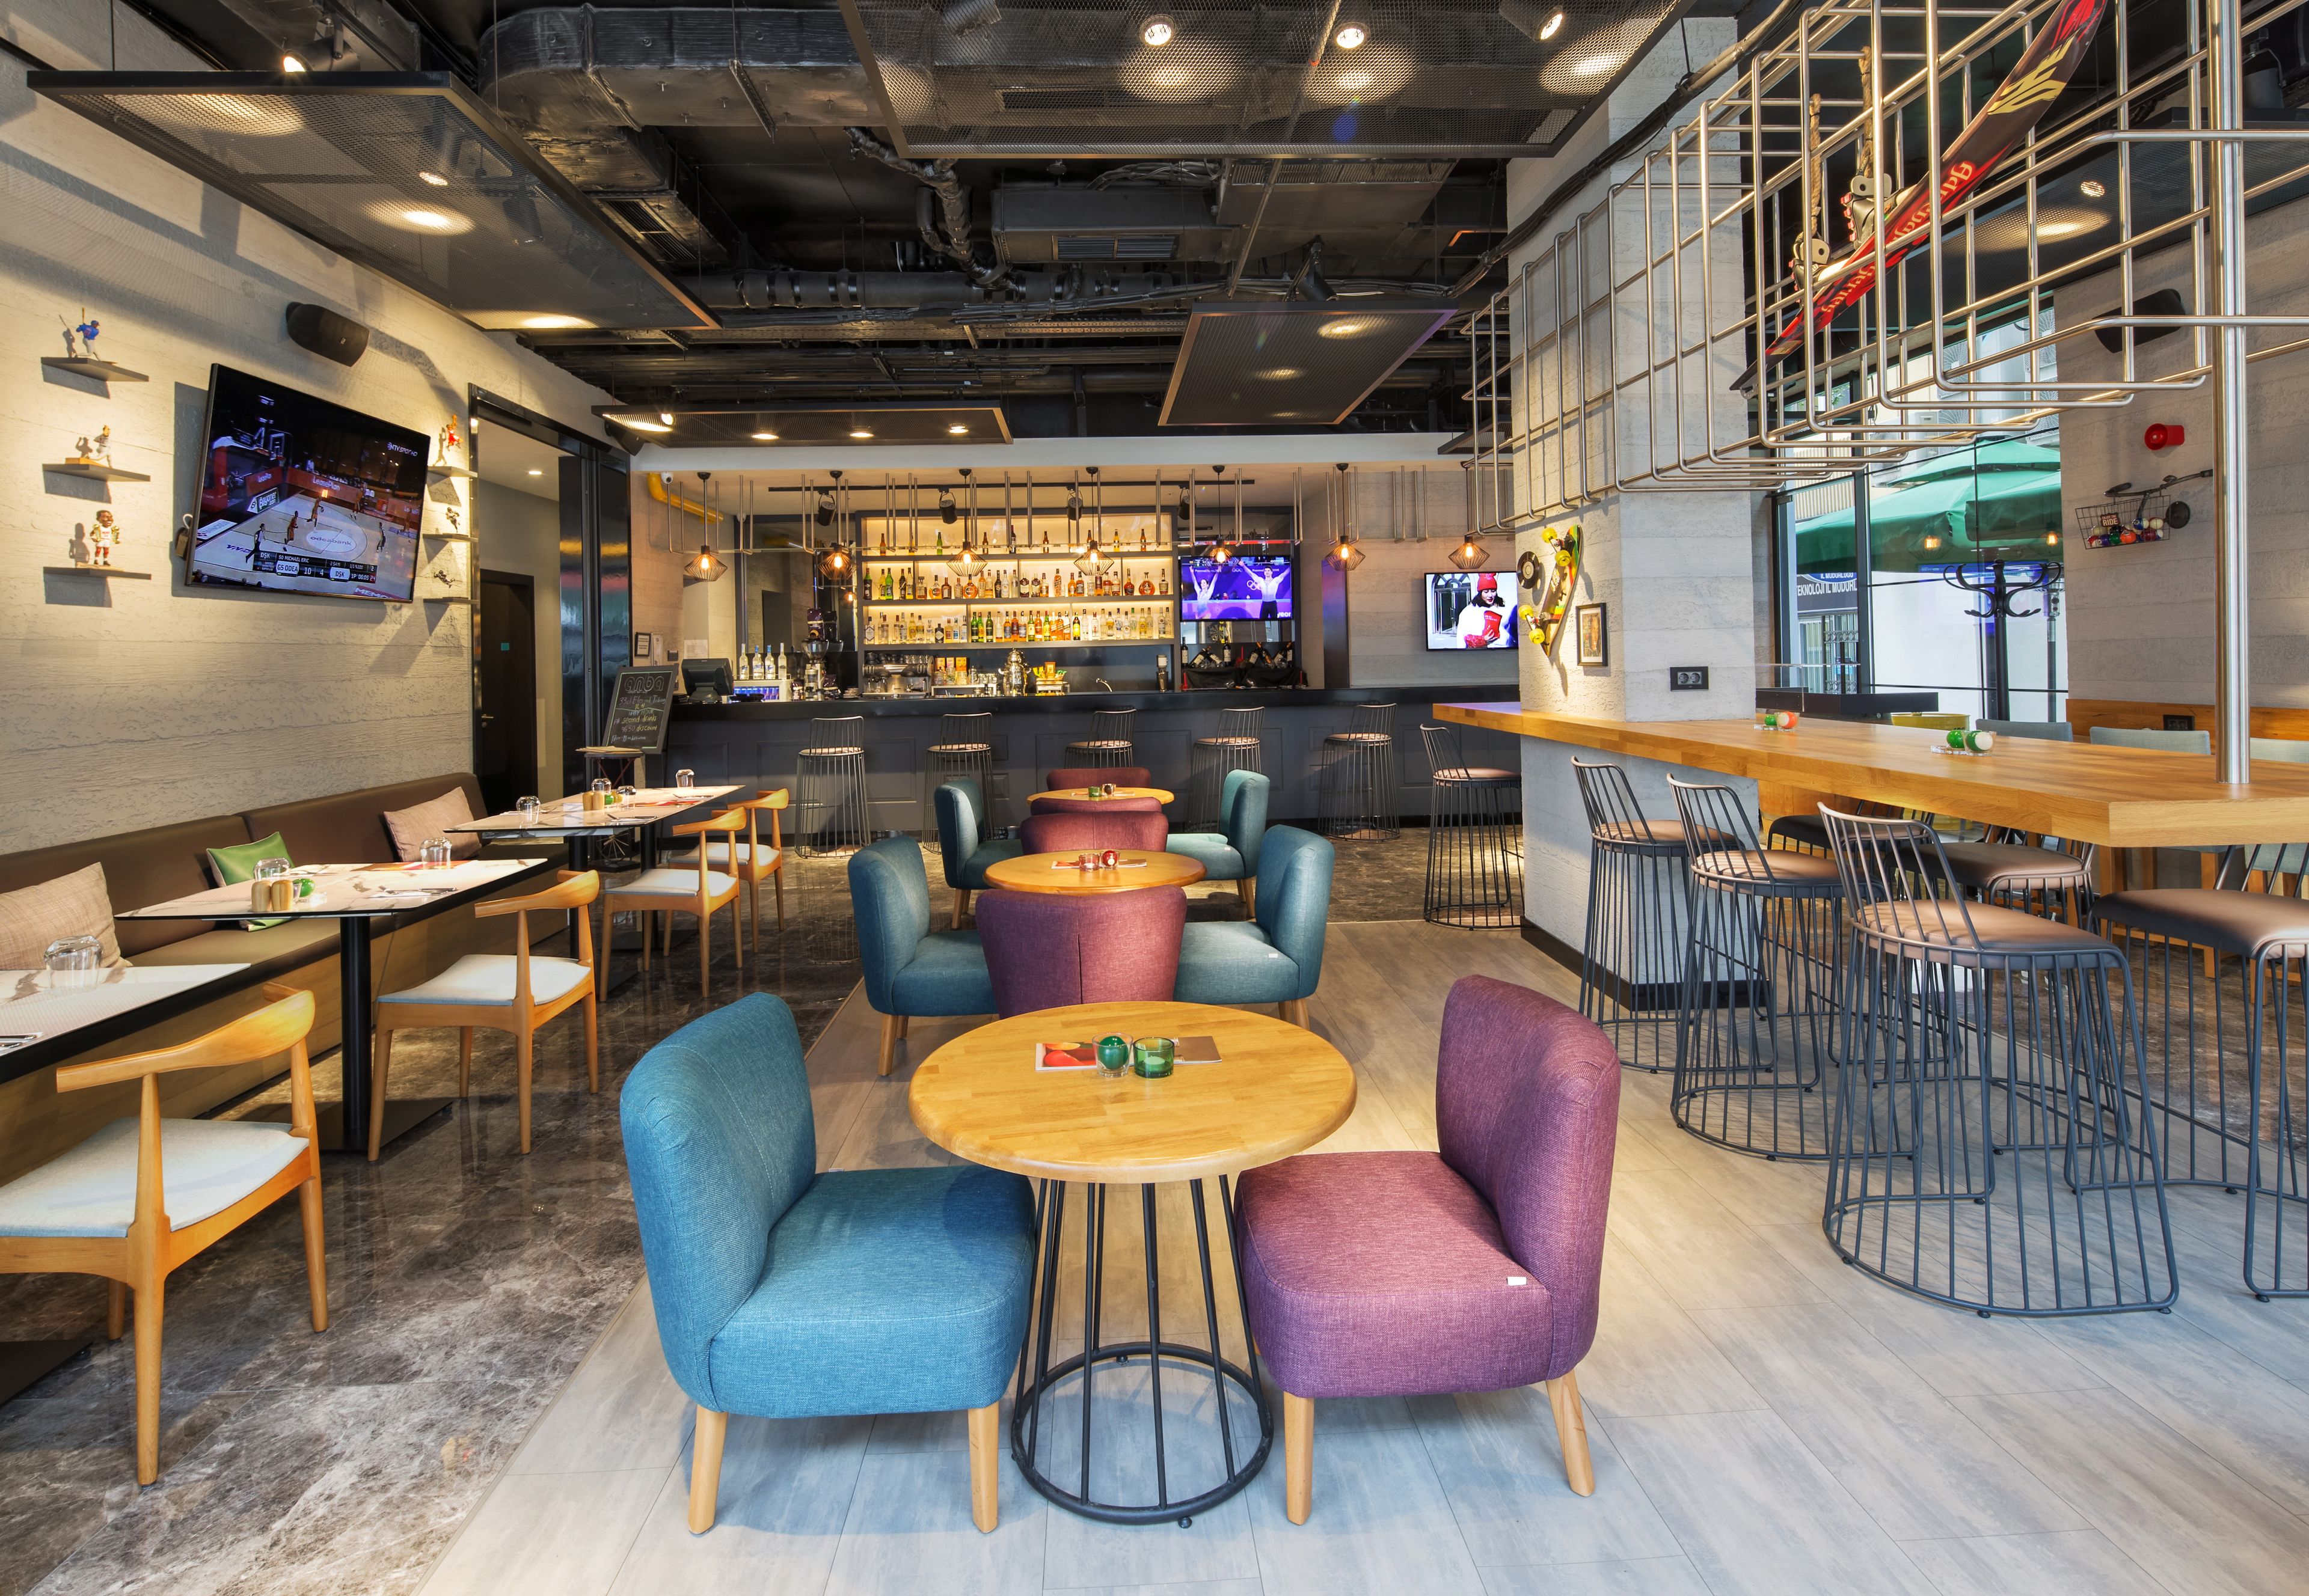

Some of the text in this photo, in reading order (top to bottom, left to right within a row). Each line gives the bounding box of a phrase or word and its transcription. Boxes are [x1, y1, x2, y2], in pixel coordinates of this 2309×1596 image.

[313, 475, 341, 491] LeasePlan
[310, 536, 352, 546] odeabank
[625, 673, 664, 691] anba
